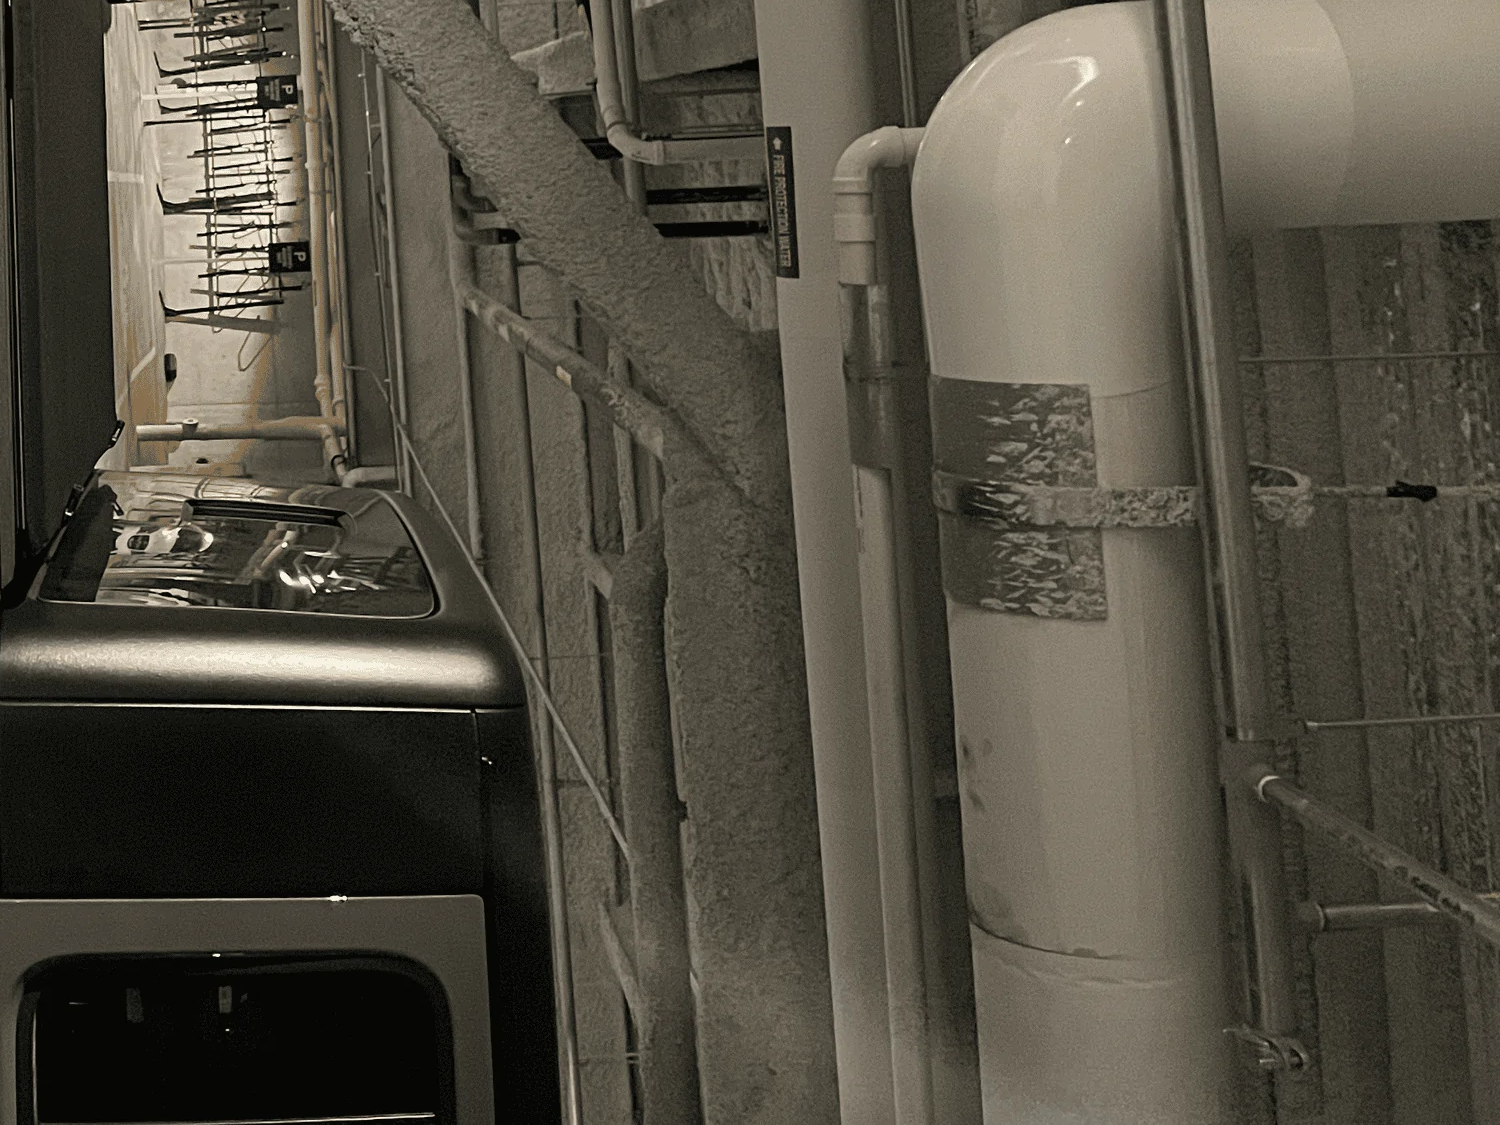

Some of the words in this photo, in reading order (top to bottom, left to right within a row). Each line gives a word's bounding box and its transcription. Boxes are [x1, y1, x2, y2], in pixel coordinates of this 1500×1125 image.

[281, 84, 293, 95] P
[772, 154, 785, 175] FIRE
[774, 176, 790, 234] PROTECTION
[293, 251, 306, 262] P
[778, 235, 791, 267] WATER
